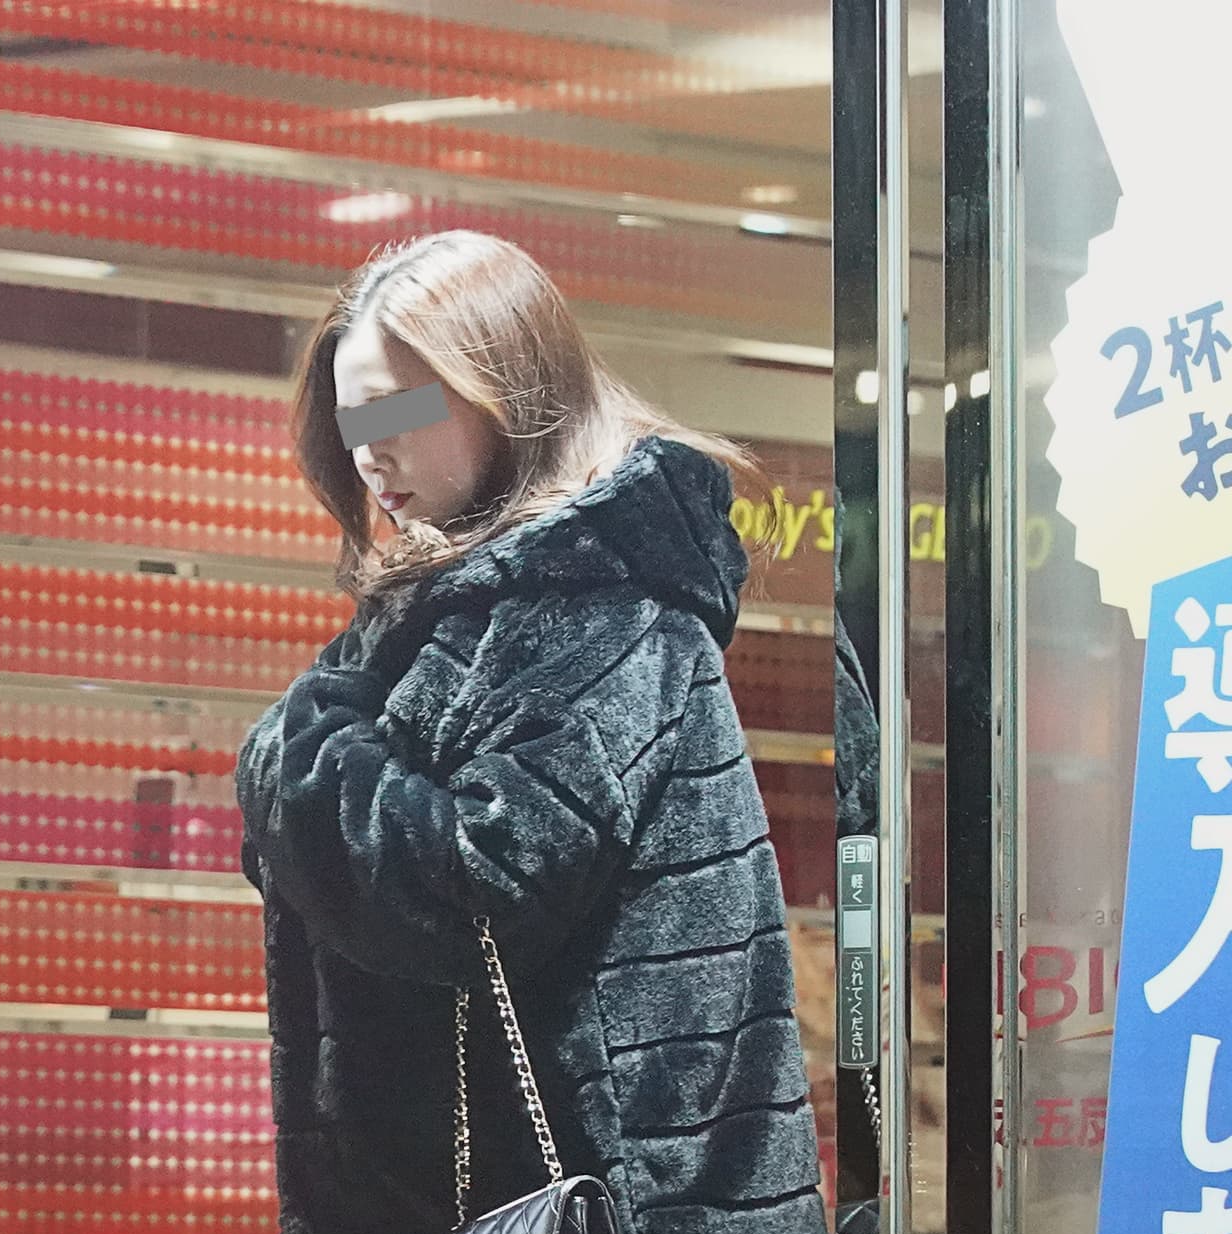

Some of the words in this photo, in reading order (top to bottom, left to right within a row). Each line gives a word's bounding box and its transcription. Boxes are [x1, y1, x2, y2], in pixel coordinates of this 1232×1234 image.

[842, 845, 872, 864] 自動
[851, 874, 865, 904] 軽く
[850, 956, 865, 1061] ふれてください
